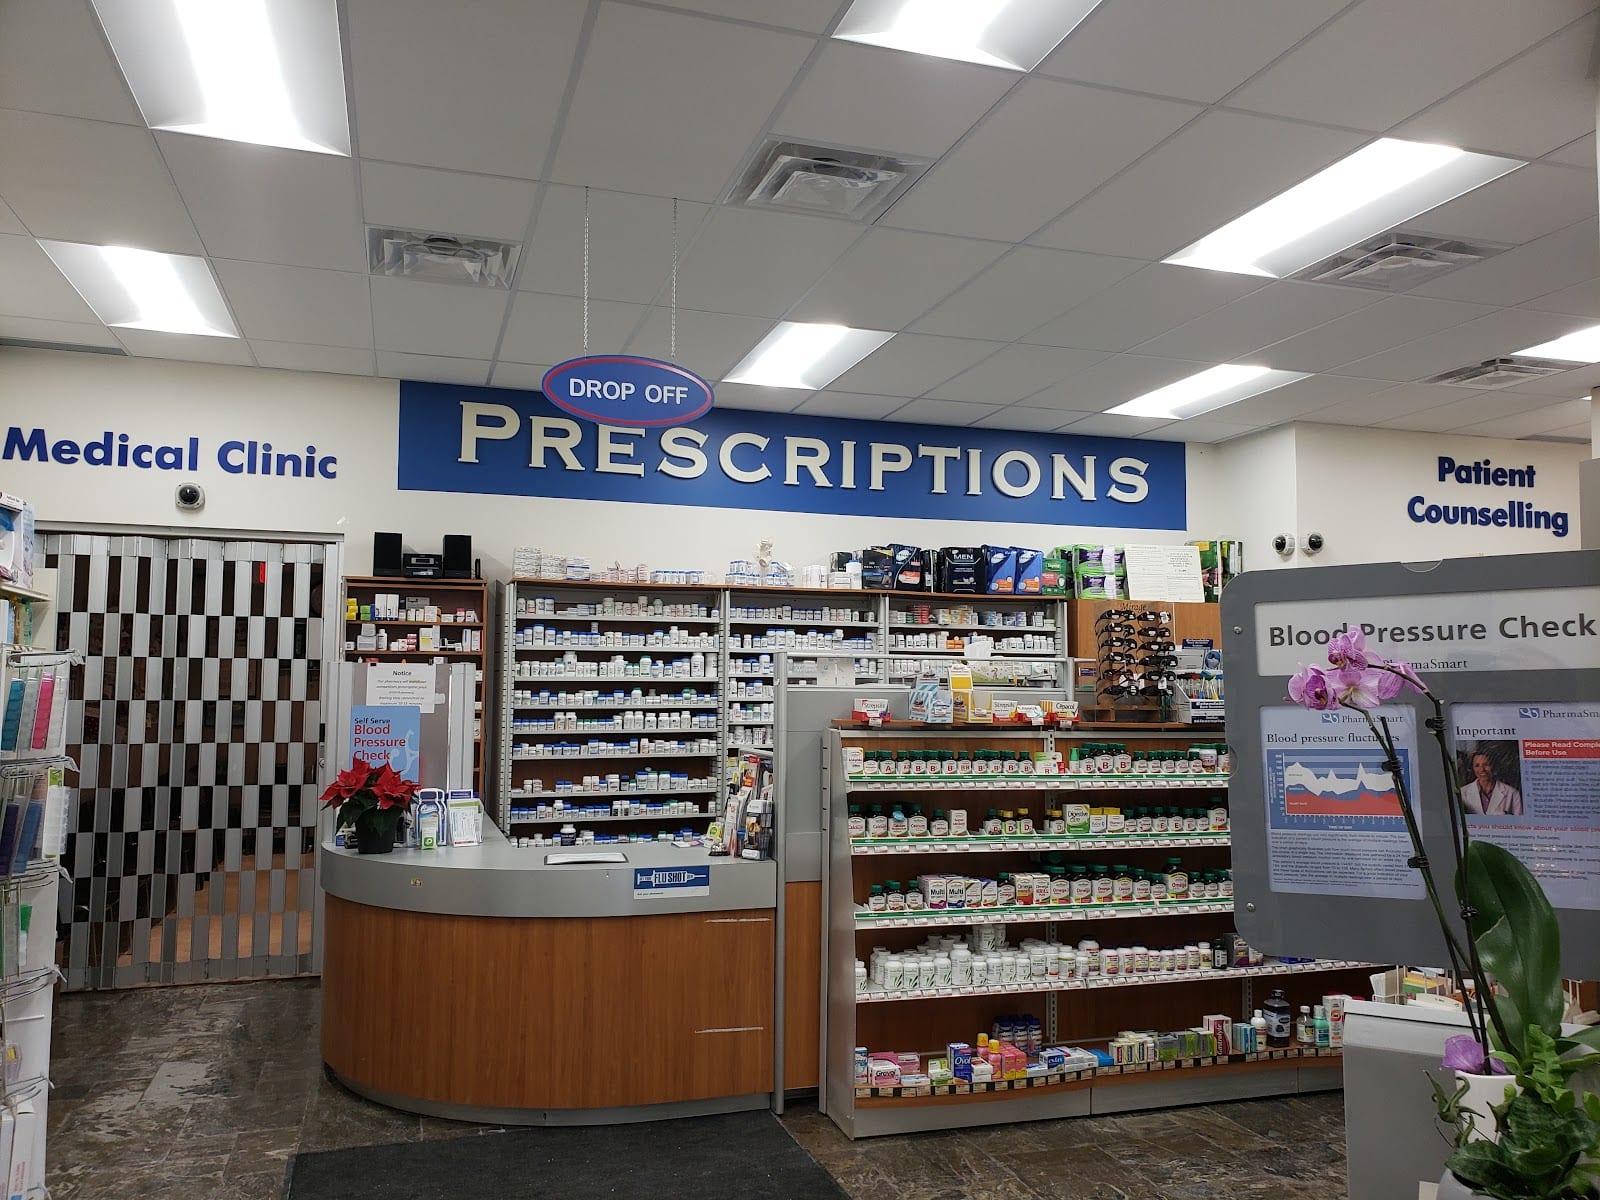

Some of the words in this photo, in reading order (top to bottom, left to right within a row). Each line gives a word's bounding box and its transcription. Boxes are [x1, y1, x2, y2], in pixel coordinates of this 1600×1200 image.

[568, 378, 636, 402] DROP
[645, 384, 688, 405] OFF
[2, 426, 200, 472] Medical
[217, 440, 338, 480] Clinic
[457, 400, 1150, 504] PRESCRIPTIONS
[1438, 456, 1536, 488] Patient
[1407, 496, 1569, 538] Counselling
[1268, 622, 1348, 646] Blood
[1360, 622, 1487, 644] Pressure
[1498, 613, 1598, 639] Check
[354, 724, 390, 735] Blood
[1456, 726, 1516, 738] Important
[354, 737, 406, 748] Pressure
[1266, 732, 1298, 744] Blood
[1300, 734, 1344, 744] pressure
[353, 750, 390, 761] Check
[654, 872, 667, 884] FLU
[668, 872, 686, 883] SHOT
[955, 1056, 971, 1066] Ovol
[876, 1069, 896, 1077] Gravol
